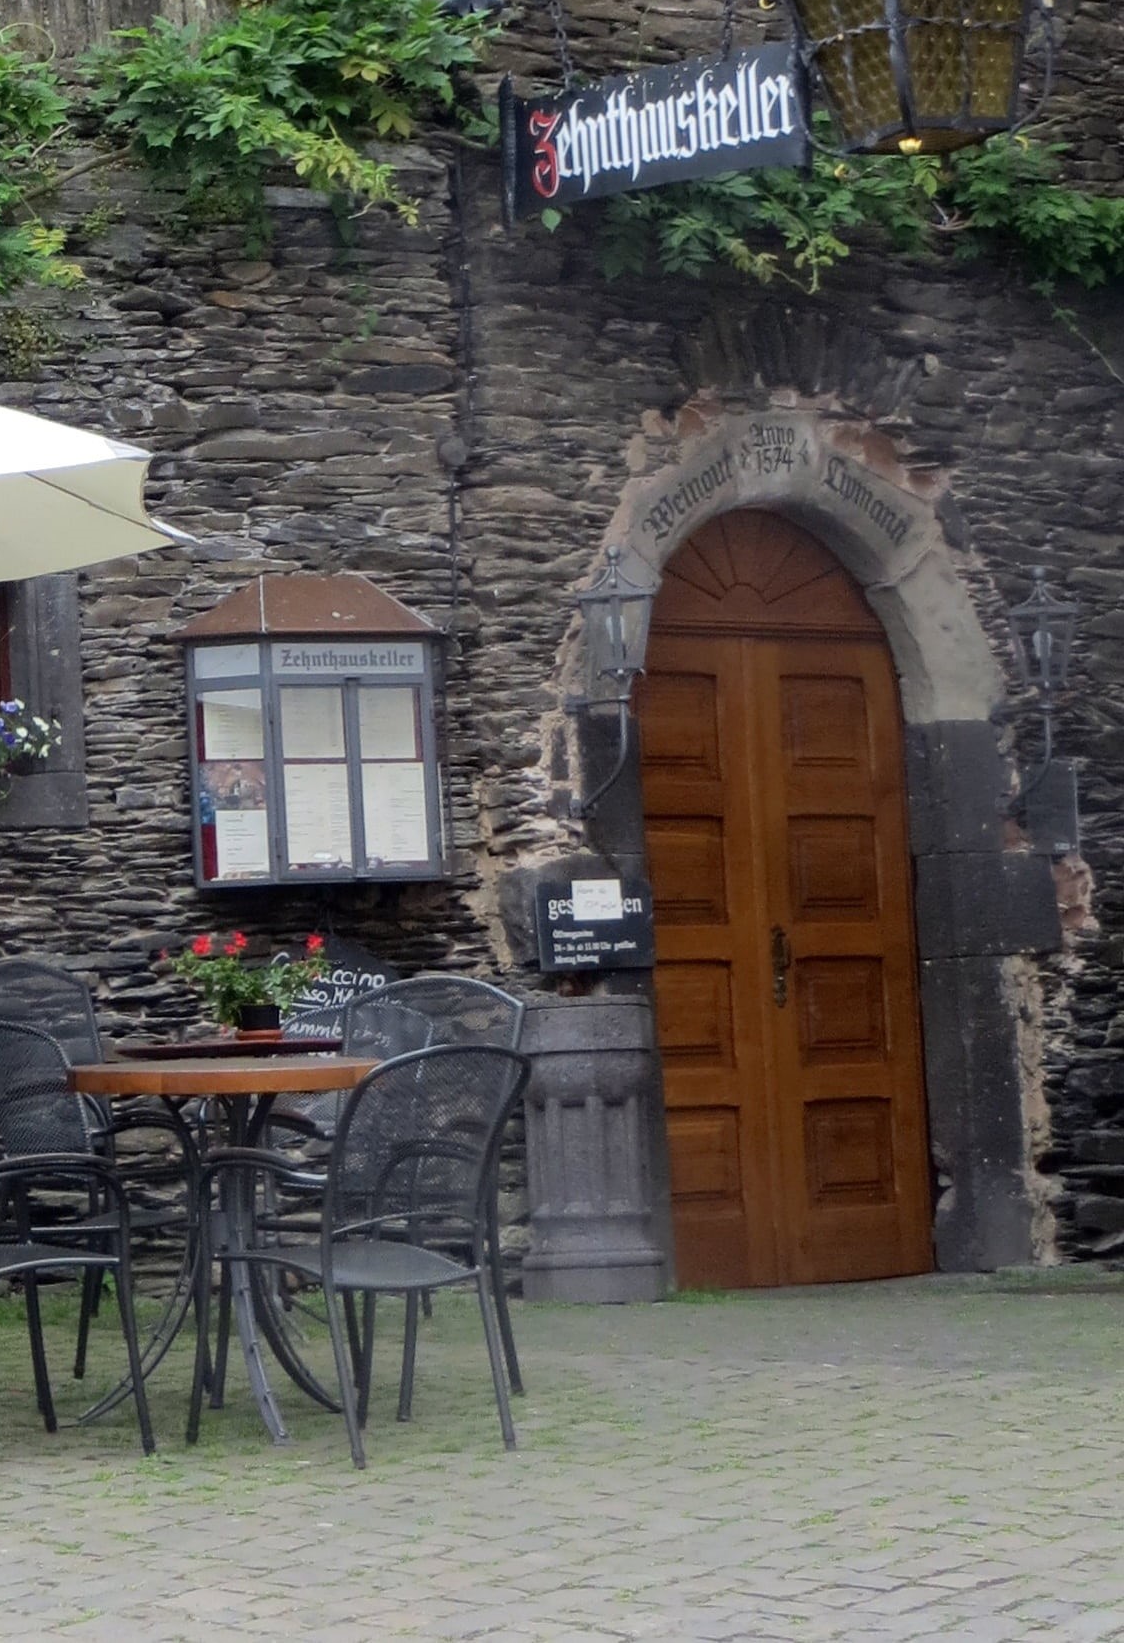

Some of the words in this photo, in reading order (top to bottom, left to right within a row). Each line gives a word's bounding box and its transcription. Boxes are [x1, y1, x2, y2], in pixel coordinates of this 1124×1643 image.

[529, 58, 796, 198] Zehnthauskeller
[749, 422, 795, 447] Anno
[756, 447, 794, 474] 1574
[641, 447, 734, 542] Weingut
[281, 649, 415, 670] Zehnthauskeller
